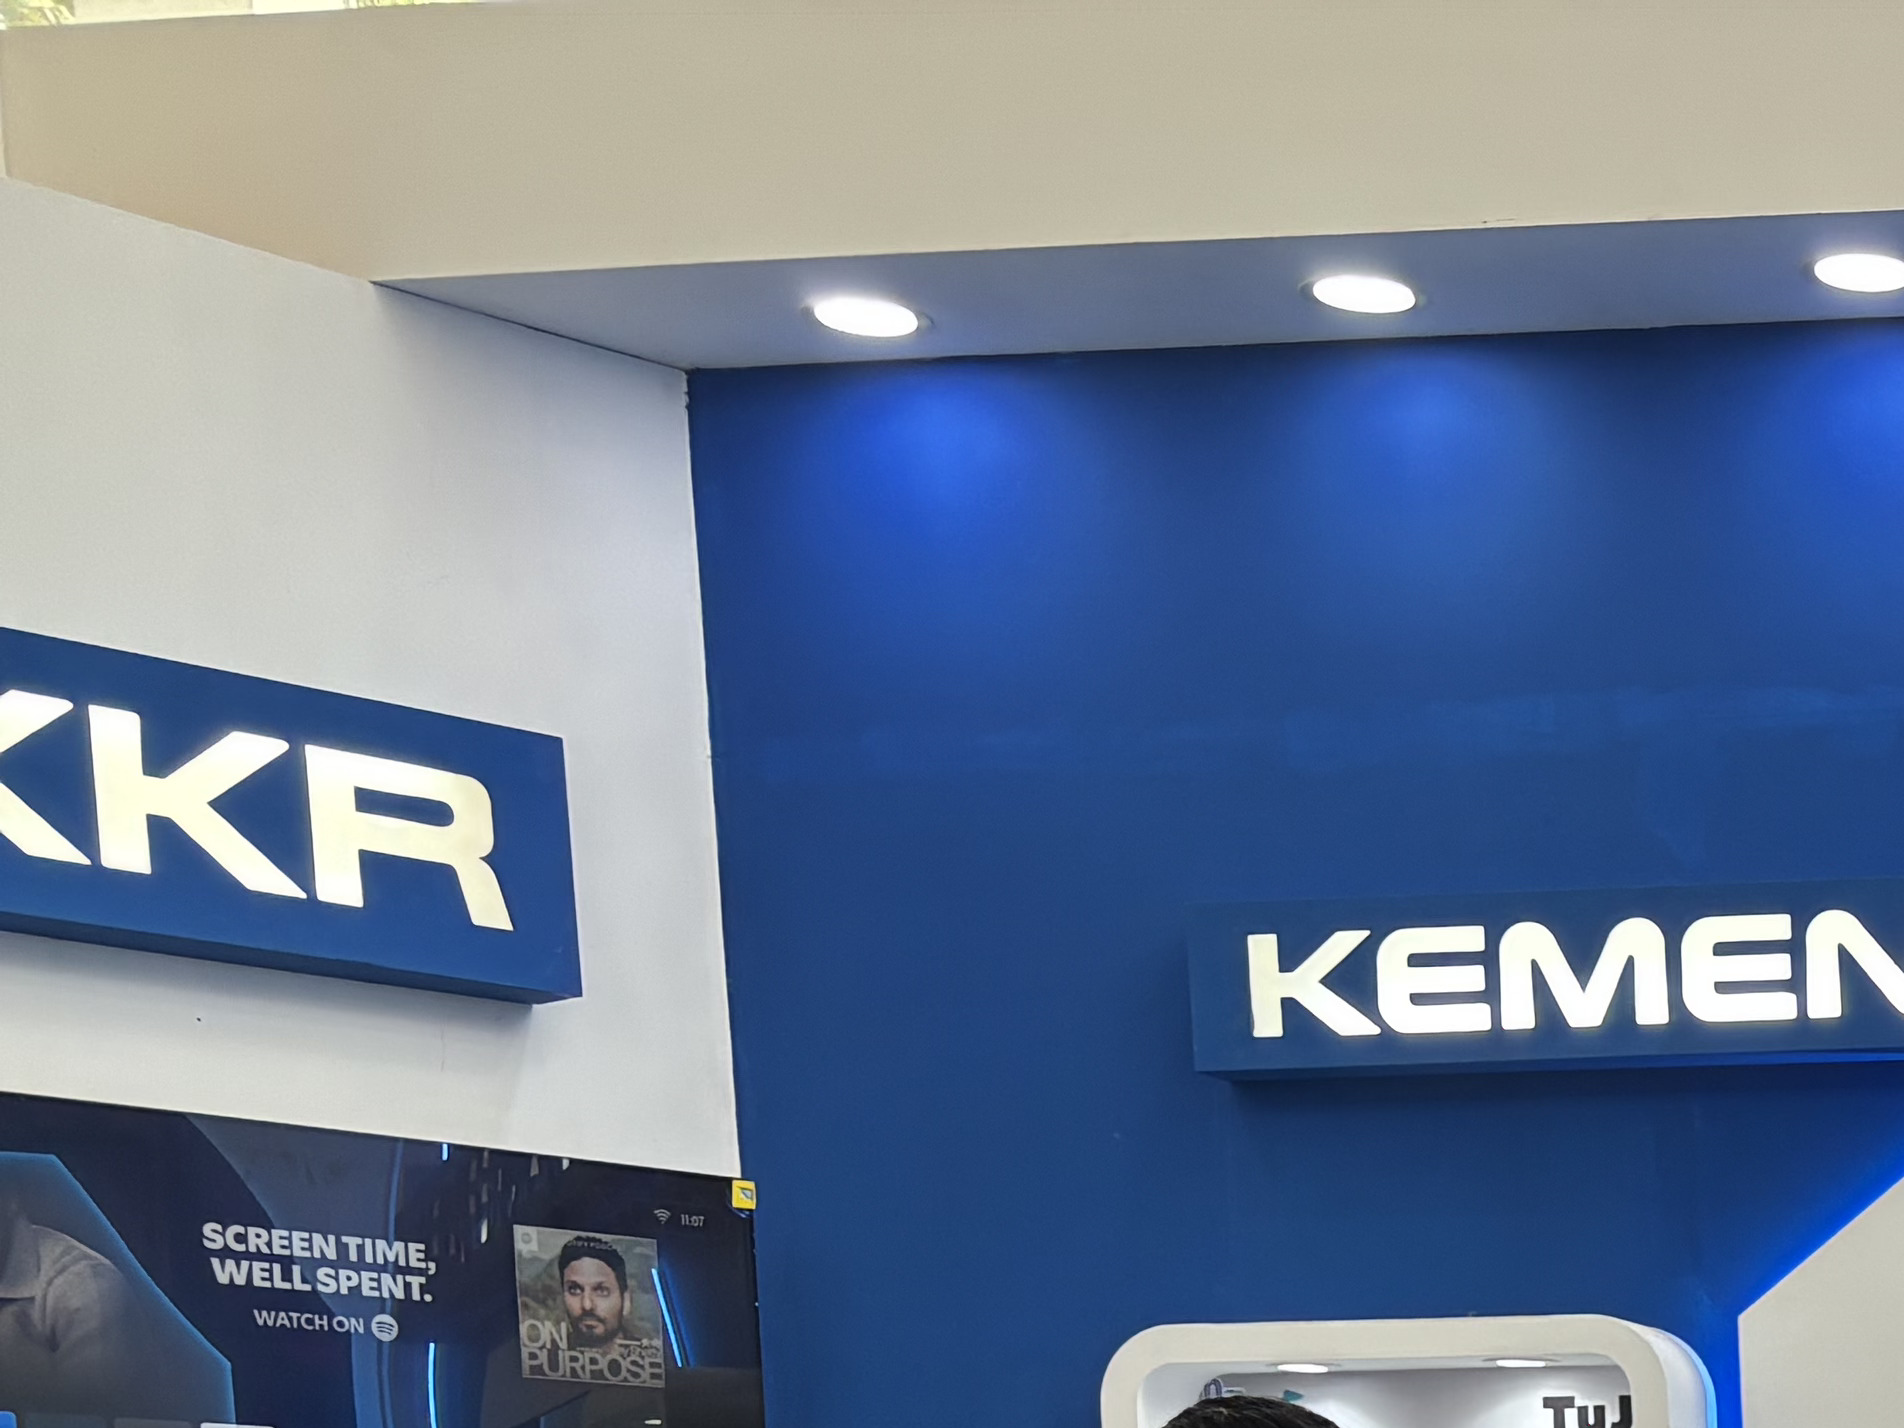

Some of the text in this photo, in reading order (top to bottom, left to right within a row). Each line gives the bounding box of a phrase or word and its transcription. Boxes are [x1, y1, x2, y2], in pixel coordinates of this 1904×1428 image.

[202, 1221, 437, 1275] SCREEN TIME,
[210, 1257, 433, 1302] WELL SPENT.
[253, 1309, 365, 1333] WATCH ON
[523, 1319, 567, 1349] ON
[524, 1348, 663, 1384] PURPOSE
